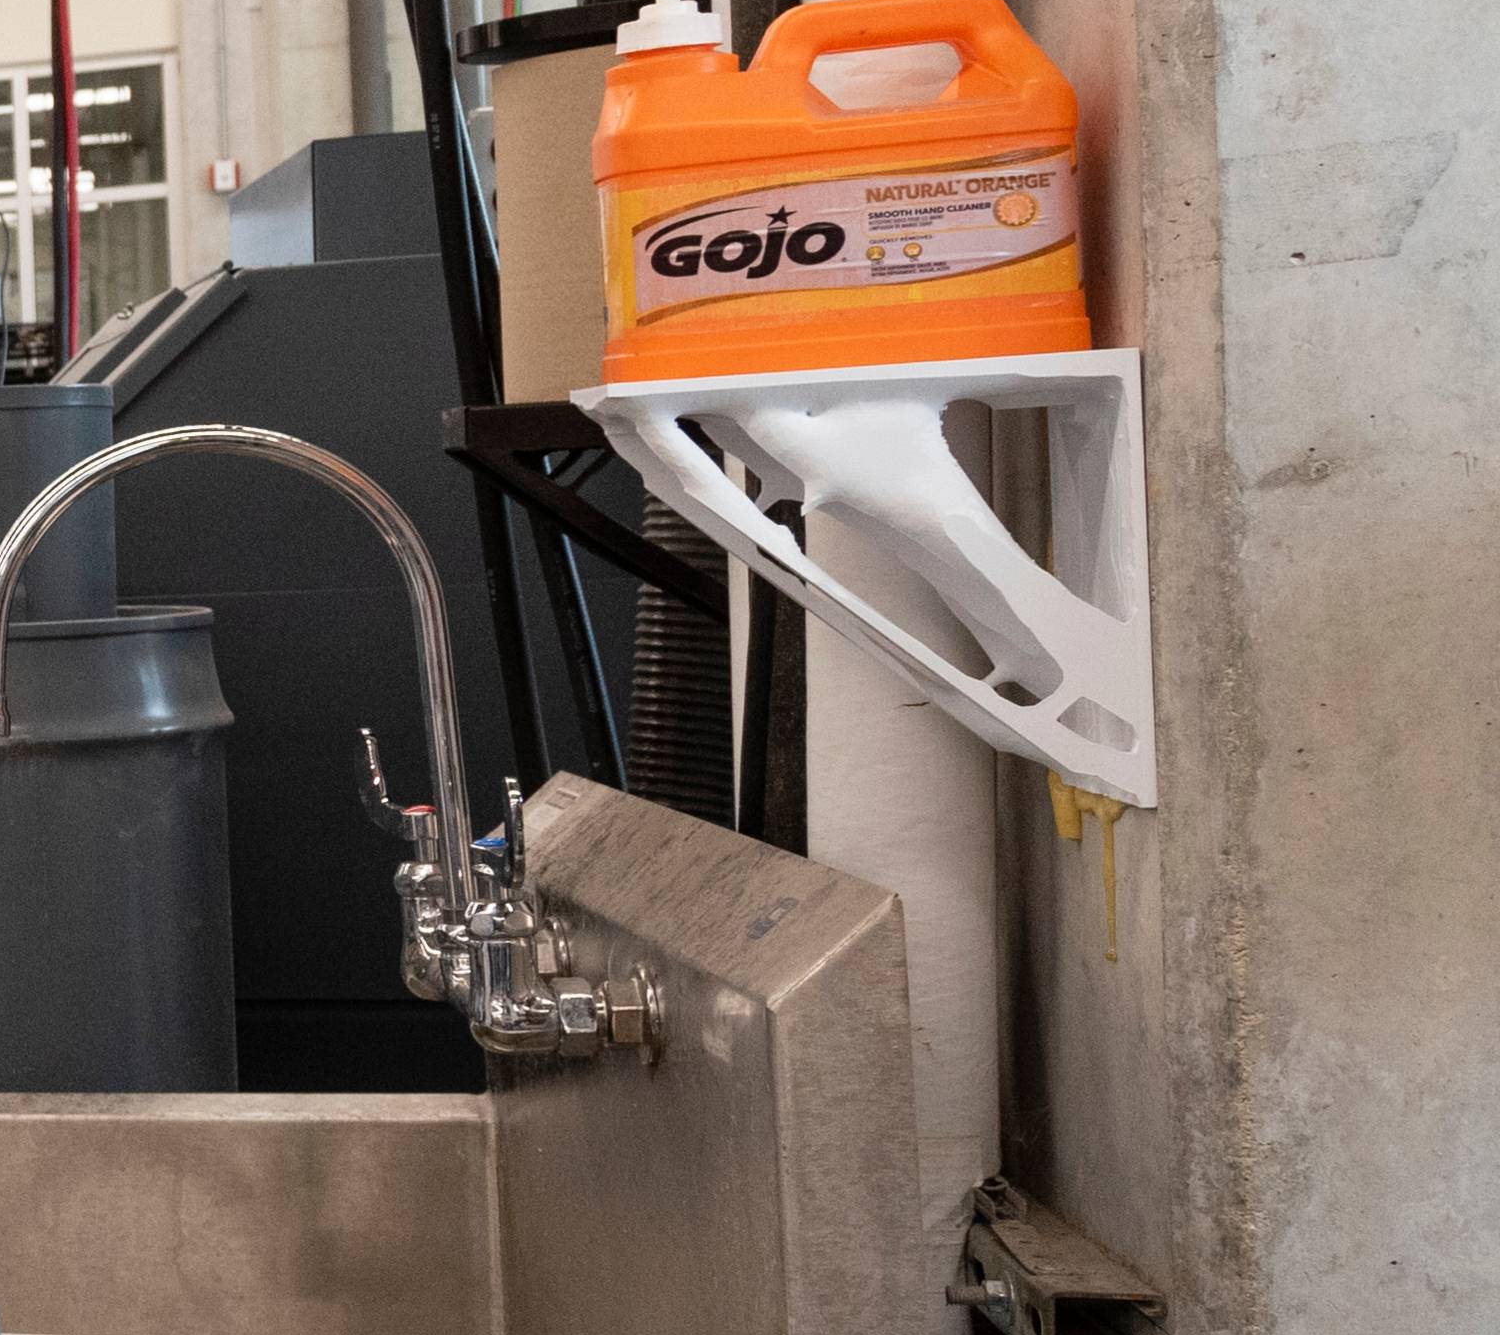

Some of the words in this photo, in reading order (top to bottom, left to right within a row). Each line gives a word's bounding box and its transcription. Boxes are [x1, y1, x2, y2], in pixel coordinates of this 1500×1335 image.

[864, 181, 959, 204] NATURAL
[965, 173, 1051, 194] ORANGE
[867, 209, 913, 220] SMOOTH
[914, 206, 945, 217] HAND
[946, 202, 992, 213] CLEANER
